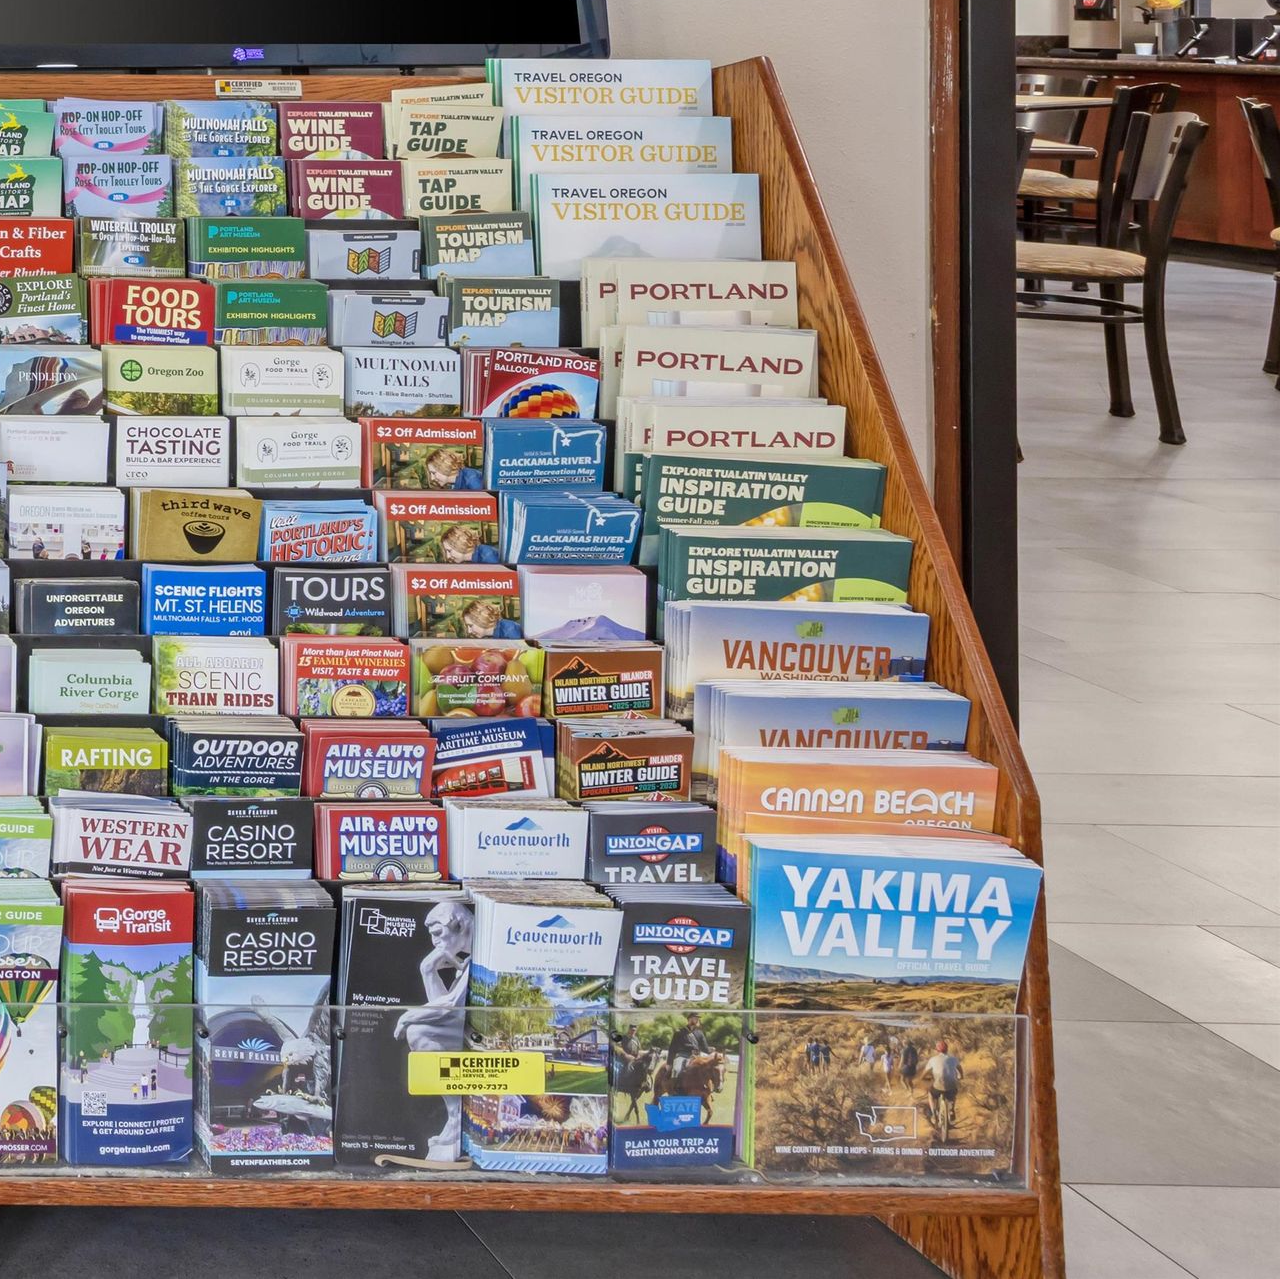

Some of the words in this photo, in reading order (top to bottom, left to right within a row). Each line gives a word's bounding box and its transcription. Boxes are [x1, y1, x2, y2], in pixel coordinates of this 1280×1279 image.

[515, 73, 565, 82] TRAVEL
[569, 73, 622, 82] OREGON
[515, 88, 615, 104] VISITOR
[620, 88, 697, 104] GUIDE
[183, 119, 239, 131] MULTNOMAH
[241, 119, 268, 131] FALLS
[288, 119, 345, 134] WINE
[410, 122, 447, 136] TAP
[288, 137, 351, 151] GUIDE
[407, 138, 467, 152] GUIDE
[77, 163, 115, 173] HOP-ON
[117, 162, 159, 173] HOP-OFF
[553, 188, 605, 198] TRAVEL
[610, 188, 667, 198] OREGON
[553, 203, 657, 221] VISITOR
[664, 203, 745, 221] GUIDE
[13, 228, 24, 239] &
[28, 227, 66, 239] Fiber
[437, 231, 524, 246] TOURISM
[0, 246, 41, 258] Crafts
[439, 248, 481, 262] MAP
[16, 279, 73, 292] EXPLORE
[631, 283, 788, 300] PORTLAND
[21, 291, 70, 303] Portland's
[126, 286, 200, 308] FOOD
[462, 297, 551, 311] TOURISM
[17, 303, 45, 313] Finest
[50, 302, 76, 312] Home
[122, 305, 201, 330] TOURS
[462, 312, 507, 326] MAP
[273, 357, 300, 366] Gorge
[355, 357, 456, 372] MULTNOMAH
[495, 351, 562, 366] PORTLAND
[565, 359, 596, 372] ROSE
[19, 371, 77, 381] PENDLETON
[148, 368, 183, 377] Oregon
[185, 369, 204, 377] Zoo
[494, 364, 539, 375] BALLOONS
[384, 375, 429, 388] FALLS
[127, 427, 221, 438] CHOCOLATE
[377, 426, 391, 437] $2
[394, 426, 413, 437] Off
[416, 426, 476, 438] Admission!
[667, 430, 836, 448] PORTLAND
[126, 440, 220, 455] TASTING
[662, 466, 713, 477] EXPLORE
[714, 469, 767, 481] TUALATIN
[768, 473, 808, 483] VALLEY
[660, 477, 805, 501] INSPIRATION
[161, 500, 210, 512] third
[213, 503, 251, 519] wave
[657, 497, 725, 515] GUIDE
[208, 513, 229, 521] tours
[531, 535, 591, 543] CLACKAMAS
[155, 585, 206, 595] SCENIC
[209, 586, 262, 596] FLIGHTS
[286, 577, 385, 601] TOURS
[46, 594, 123, 603] UNFORGETTABLE
[65, 606, 104, 614] OREGON
[155, 600, 181, 612] MT.
[184, 601, 206, 613] ST.
[209, 601, 262, 613] HELENS
[305, 608, 342, 617] Wildwood
[344, 609, 384, 617] Adventures
[55, 619, 115, 627] ADVENTURES
[723, 639, 891, 678] VANCOUVER
[334, 667, 361, 675] TASTE
[371, 669, 399, 677] ENJOY
[67, 674, 132, 685] Columbia
[179, 672, 261, 690] SCENIC
[60, 686, 94, 697] River
[98, 688, 139, 701] Gorge
[167, 693, 220, 706] TRAIN
[224, 694, 274, 707] RIDES
[555, 686, 608, 703] WINTER
[611, 683, 649, 699] GUIDE
[193, 740, 298, 756] OUTDOOR
[327, 745, 362, 757] AIR
[364, 747, 373, 757] &
[376, 745, 425, 758] AUTO
[62, 749, 152, 766] RAFTING
[193, 757, 295, 769] ADVENTURES
[324, 761, 422, 778] MUSEUM
[582, 770, 633, 786] WINTER
[636, 767, 678, 783] GUIDE
[243, 776, 275, 784] GORGE
[761, 788, 863, 813] CANNON
[875, 789, 974, 815] BEACH
[81, 817, 188, 838] WESTERN
[208, 824, 294, 841] CASINO
[478, 831, 570, 849] Leavenworth
[80, 836, 182, 866] WEAR
[206, 842, 296, 859] RESORT
[605, 864, 702, 882] TRAVEL
[783, 865, 1013, 917] YAKIMA
[5, 912, 42, 920] GUIDE
[124, 908, 166, 923] Gorge
[123, 921, 171, 934] Transit
[226, 931, 315, 948] CASINO
[507, 928, 602, 946] Leavenworth
[781, 911, 1011, 960] VALLEY
[224, 949, 317, 966] RESORT
[631, 956, 731, 977] TRAVEL
[631, 979, 728, 1002] GUIDE
[462, 1058, 519, 1068] CERTIFIED
[100, 1143, 170, 1155] gorgetransit.com
[652, 1139, 679, 1147] YOUR
[682, 1138, 703, 1146] TRIP
[706, 1138, 719, 1146] AT
[626, 1147, 718, 1156] VISITUNIONGAP.COM
